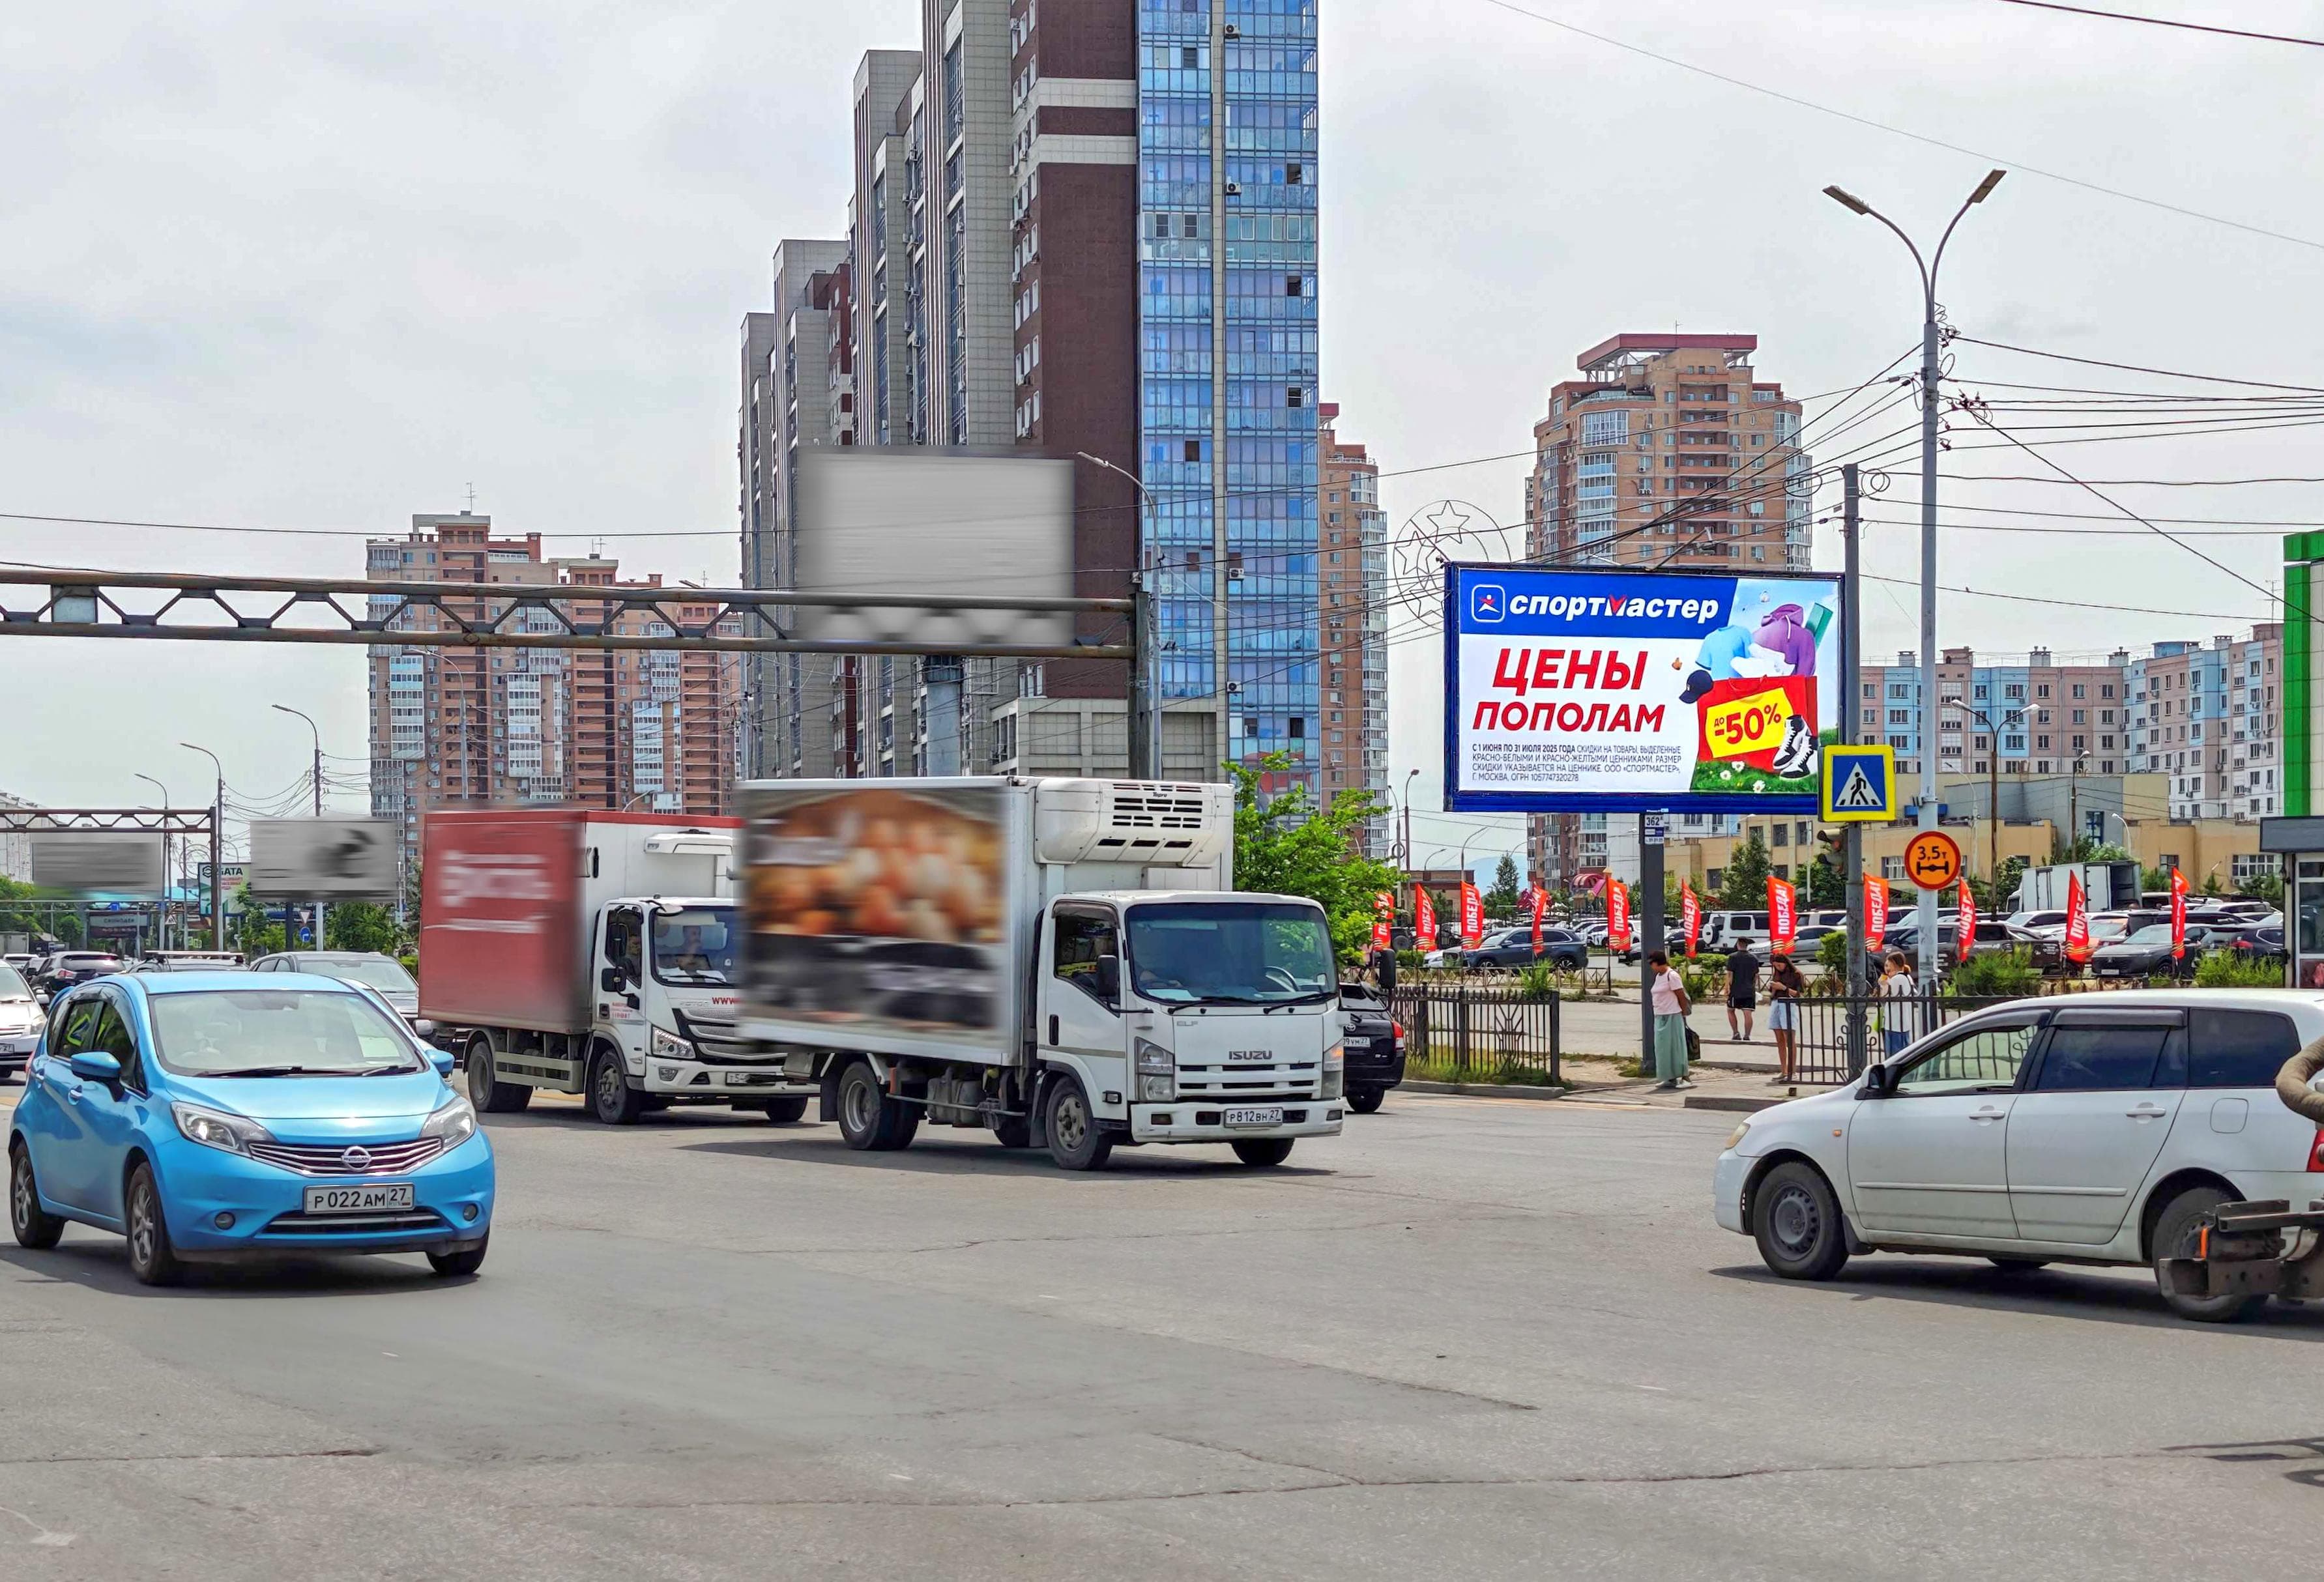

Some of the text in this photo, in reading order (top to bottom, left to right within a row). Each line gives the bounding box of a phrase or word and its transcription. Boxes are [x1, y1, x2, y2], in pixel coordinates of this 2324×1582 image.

[1509, 594, 1719, 624] спортмастер
[1492, 648, 1648, 696] ЦЕНЫ
[1473, 702, 1666, 732] ПОПОЛАМ
[1715, 703, 1781, 744] -50%
[1472, 753, 1533, 762] КРАСНО-БЕЛЫМИ
[1559, 745, 1575, 754] ГОДА
[1577, 745, 1602, 754] СКИДКИ
[1640, 746, 1681, 755] ВЫДЕЛЕННЫЕ
[1472, 763, 1502, 772] СКИДКИ
[1775, 884, 1790, 934] ПОБЕДА!
[1868, 880, 1884, 933] ПОБЕДА!
[1228, 1050, 1272, 1059] ISUZU
